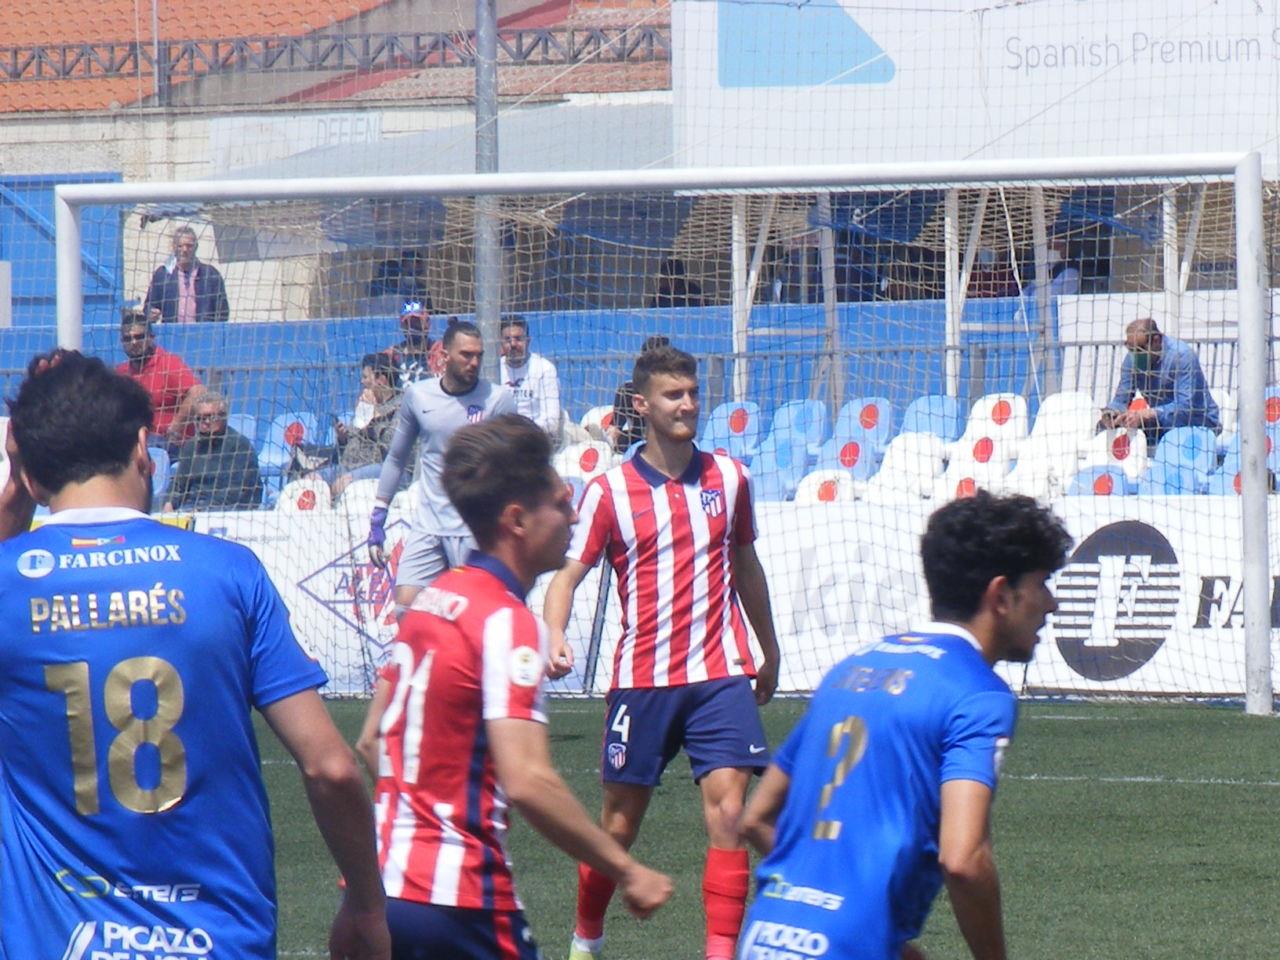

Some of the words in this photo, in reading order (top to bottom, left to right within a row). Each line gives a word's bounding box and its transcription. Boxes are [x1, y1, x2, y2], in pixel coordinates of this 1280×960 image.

[1006, 36, 1121, 75] Spanish
[1132, 32, 1261, 65] Premium
[59, 544, 182, 569] FARCINOX
[31, 582, 187, 634] PALLARÉS
[43, 655, 189, 817] 18
[611, 704, 630, 743] 4
[103, 920, 213, 955] PICAZO
